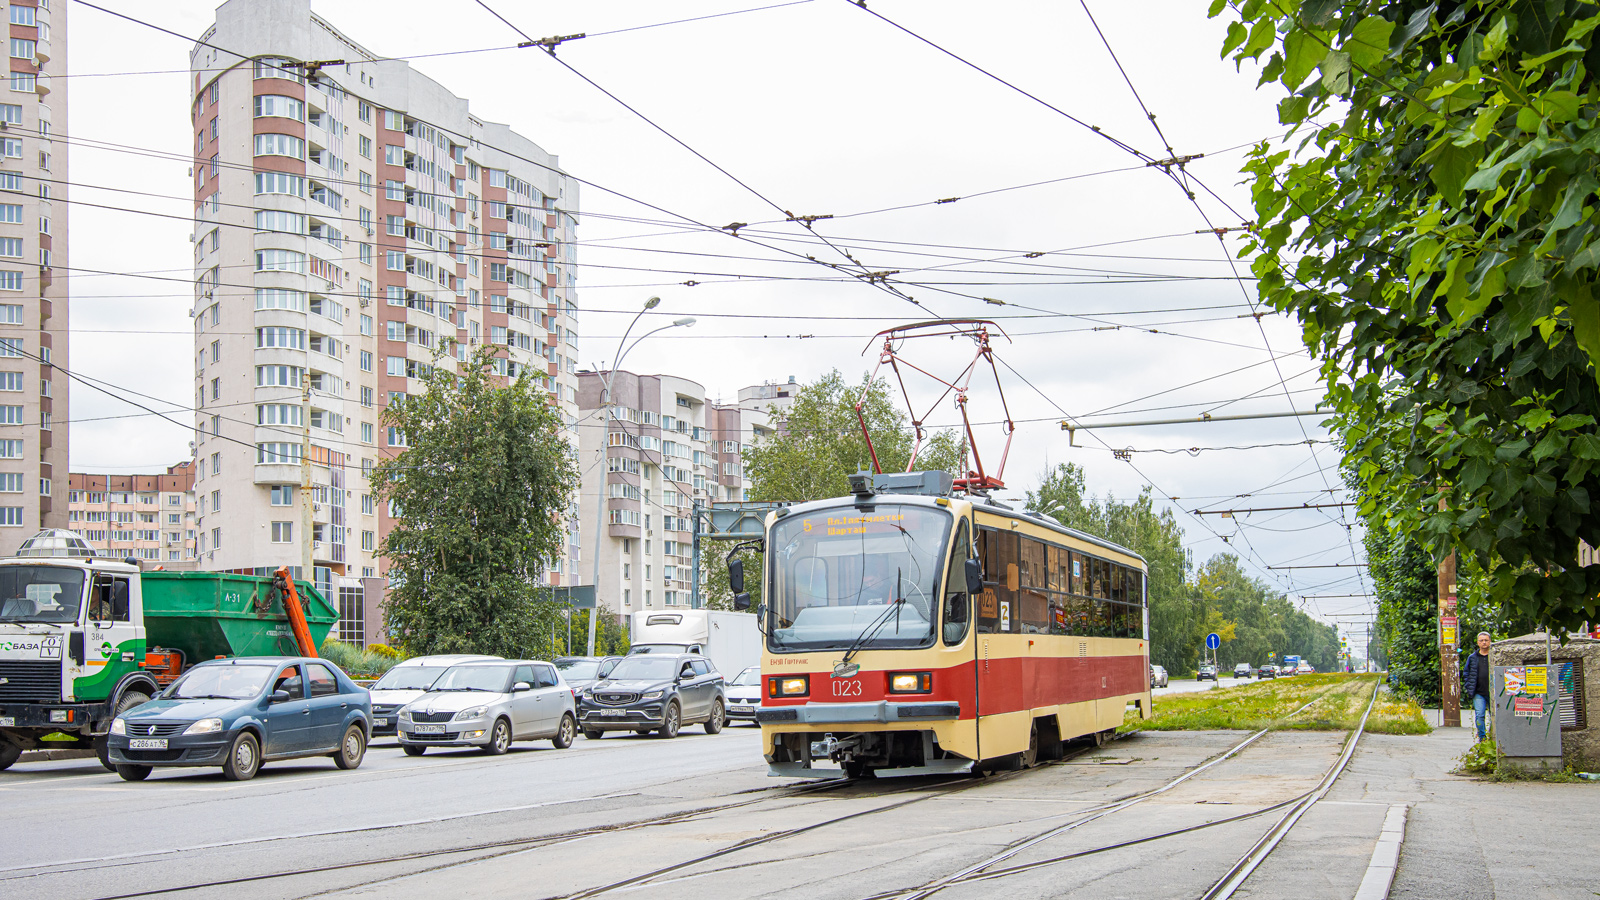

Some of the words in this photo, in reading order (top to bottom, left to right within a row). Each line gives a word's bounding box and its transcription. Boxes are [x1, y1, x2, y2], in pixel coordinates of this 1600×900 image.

[803, 519, 813, 532] 5
[827, 526, 867, 536] Шарташ
[1002, 605, 1009, 620] 2
[91, 632, 104, 641] 384
[832, 680, 862, 696] 023
